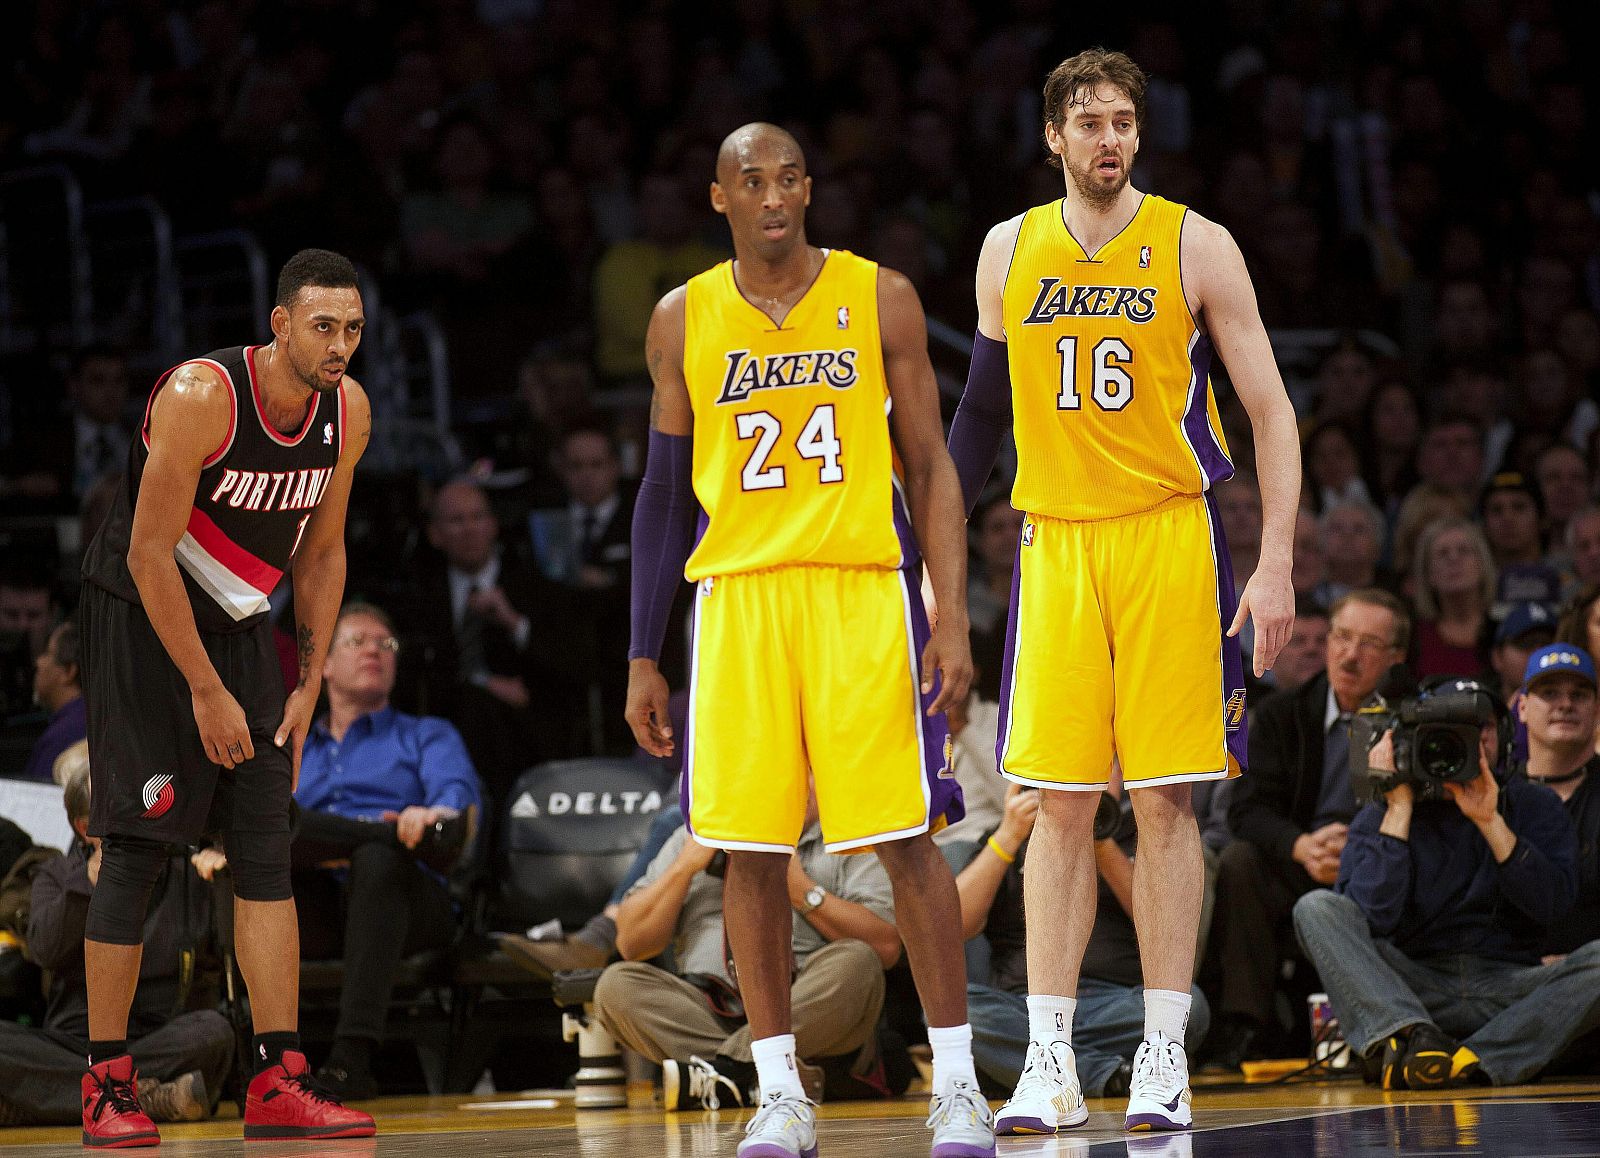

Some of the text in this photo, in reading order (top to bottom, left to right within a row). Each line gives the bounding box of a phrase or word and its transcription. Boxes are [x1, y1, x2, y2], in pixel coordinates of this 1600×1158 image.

[1021, 276, 1159, 325] LAKERS
[714, 347, 860, 407] LAKERS
[1055, 335, 1135, 412] 16
[734, 403, 844, 492] 24
[547, 790, 662, 816] DELTA
